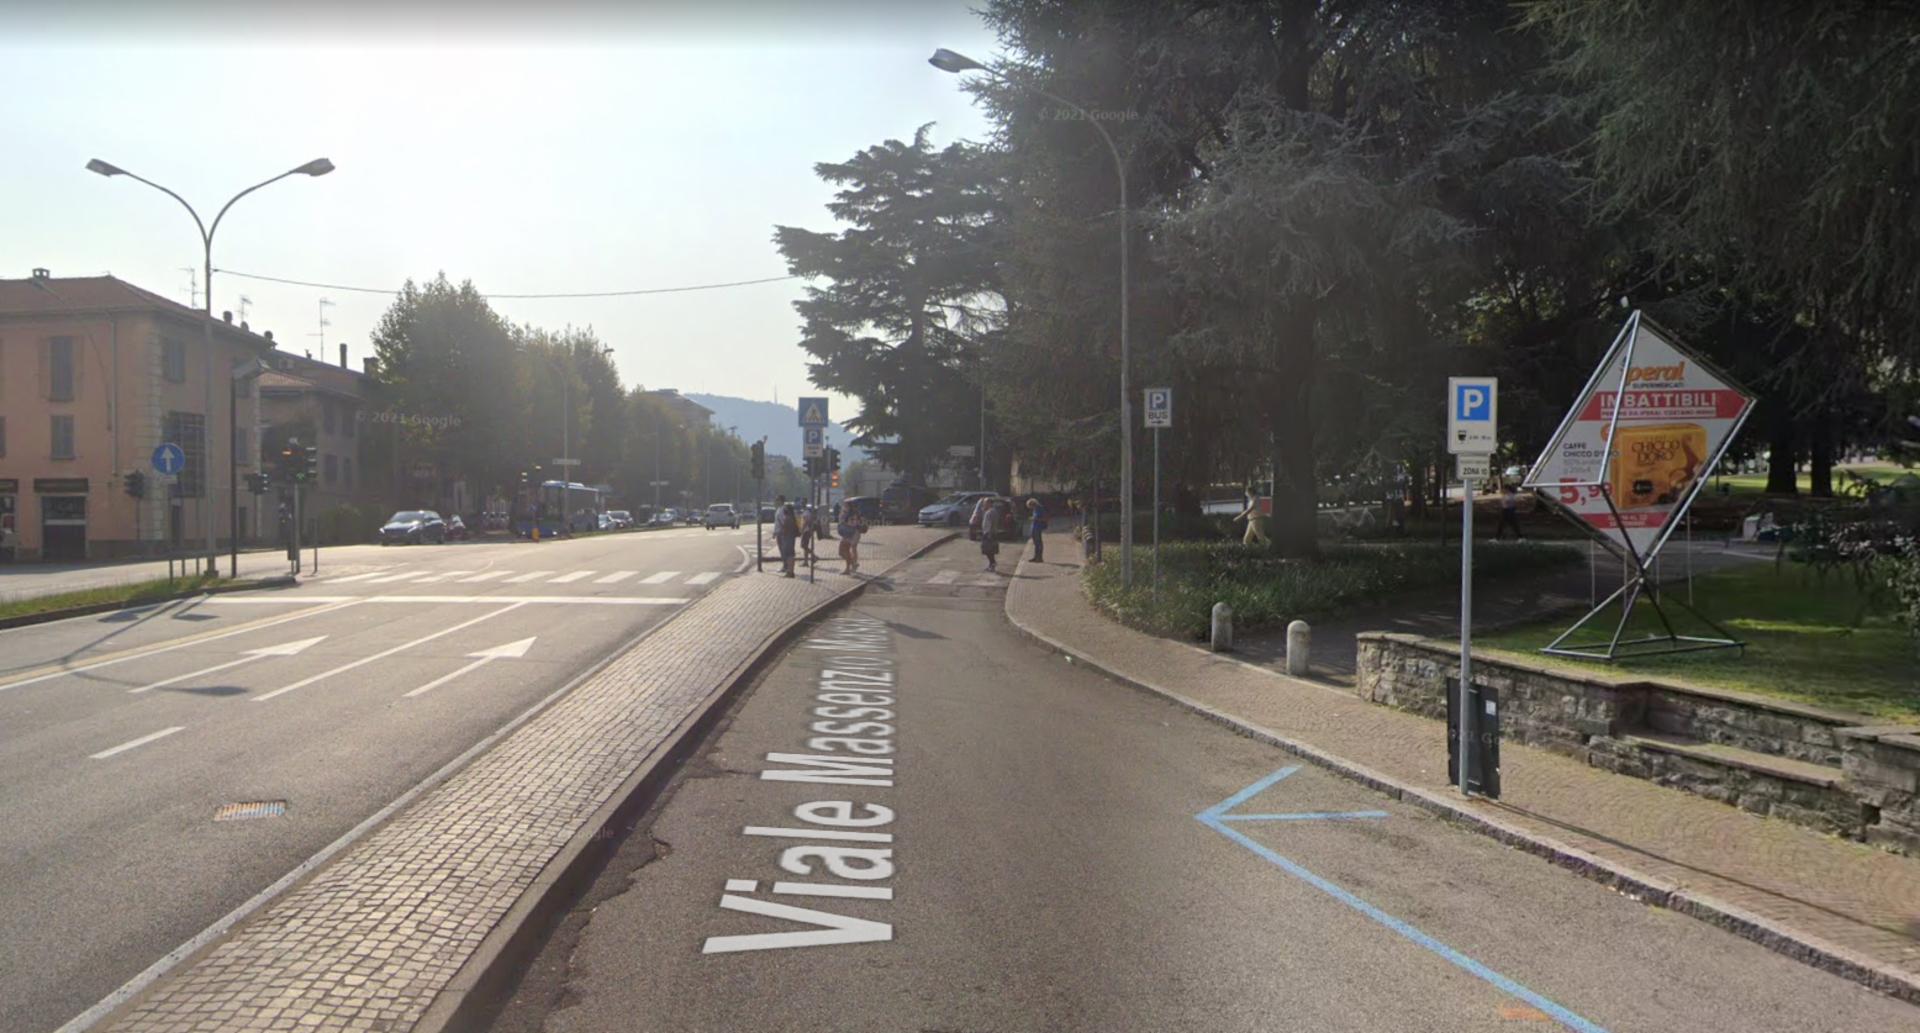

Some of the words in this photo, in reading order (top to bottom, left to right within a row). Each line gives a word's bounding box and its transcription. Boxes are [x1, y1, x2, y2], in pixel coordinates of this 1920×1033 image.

[1622, 360, 1686, 386] peral
[1463, 388, 1484, 417] P
[1149, 411, 1168, 419] BUS
[1562, 450, 1592, 458] CHICCO
